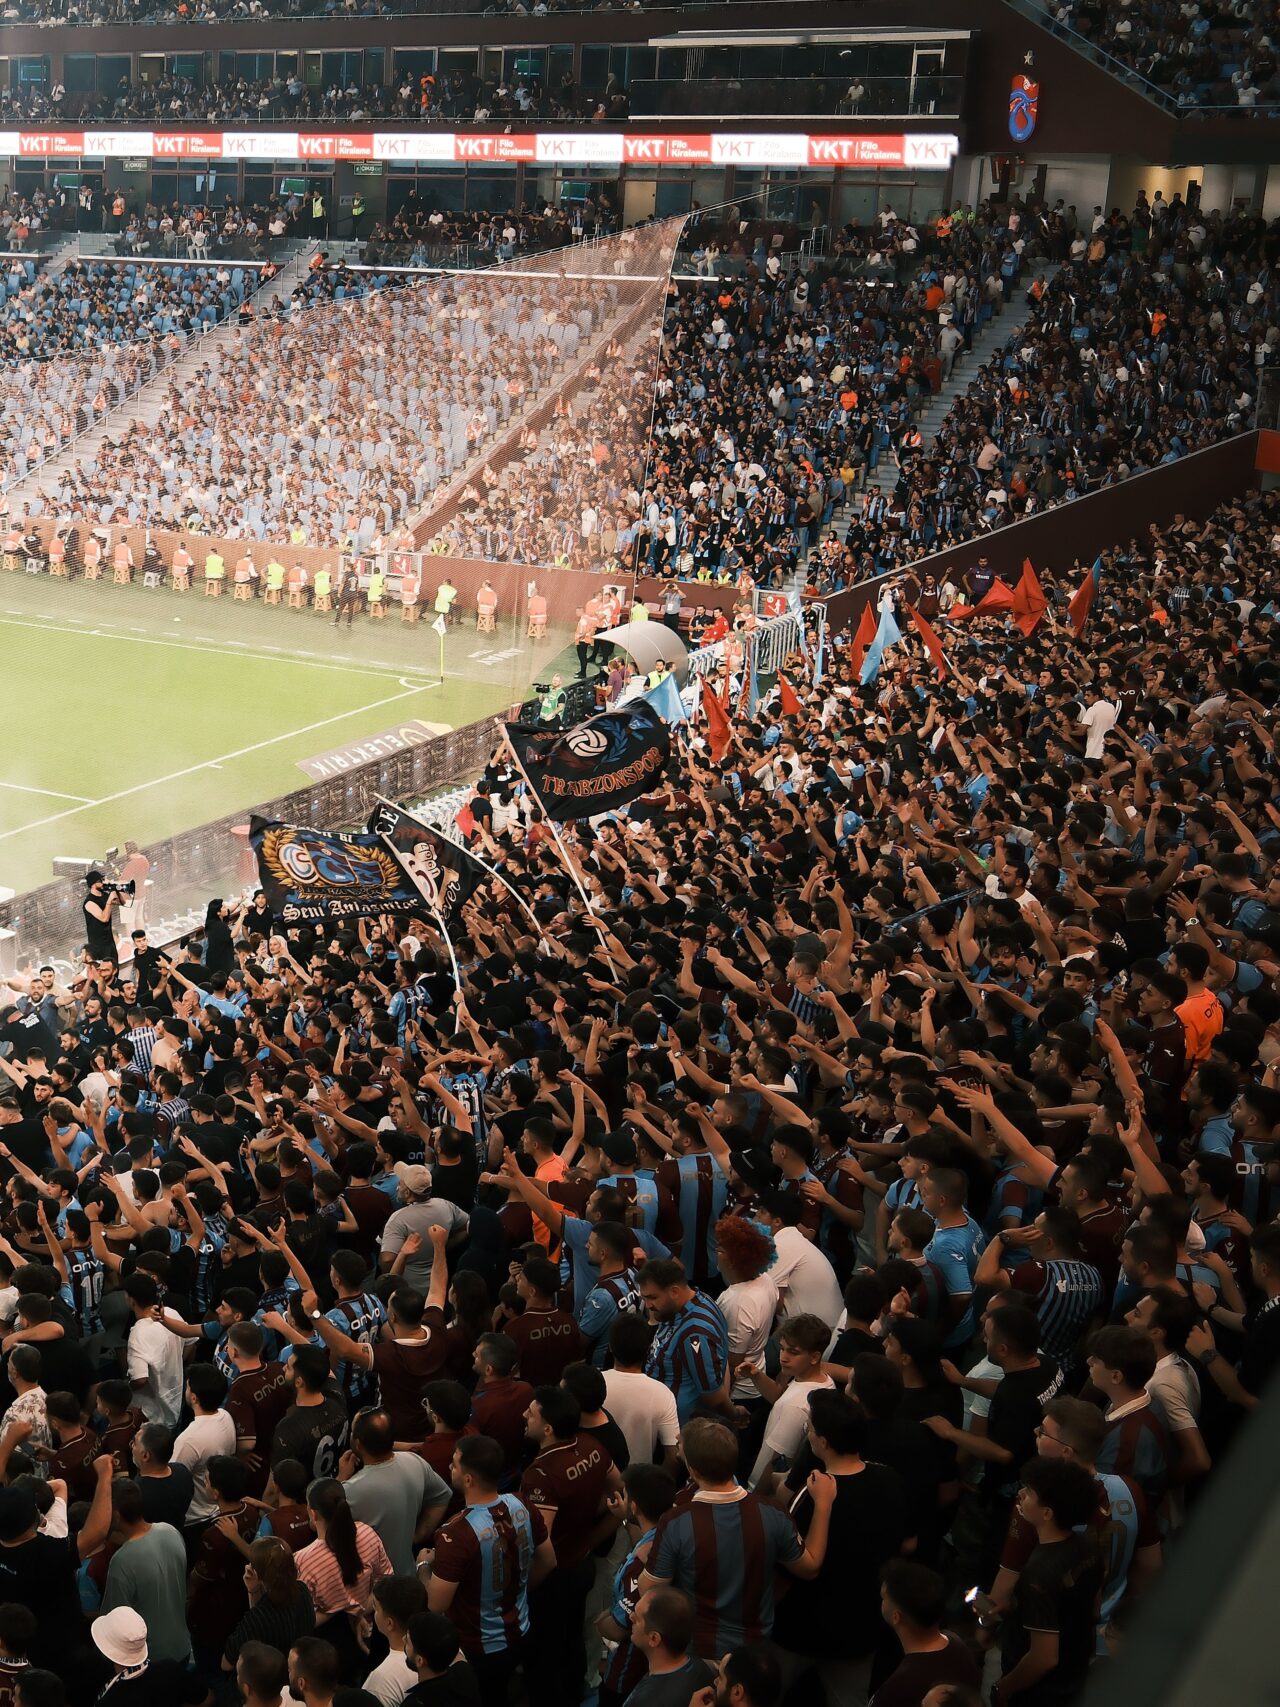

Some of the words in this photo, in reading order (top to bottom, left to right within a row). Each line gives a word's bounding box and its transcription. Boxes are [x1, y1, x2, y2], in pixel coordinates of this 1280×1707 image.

[21, 137, 49, 152] YKT
[89, 138, 116, 150] YKT
[155, 137, 186, 153] YKT
[191, 145, 220, 153] Kiralama
[227, 139, 256, 152] YKT
[300, 138, 332, 154] YKT
[339, 146, 371, 154] Kiralama
[378, 140, 409, 154] YKT
[457, 139, 492, 155] YKT
[541, 141, 576, 155] YKT
[626, 140, 664, 157] YKT
[718, 142, 755, 156] YKT
[810, 141, 851, 159] YKT
[861, 142, 878, 150] Filo
[911, 143, 950, 158] YKT
[500, 148, 533, 156] Kiralama
[672, 149, 708, 158] Kiralama
[861, 151, 900, 160] Kiralama
[542, 746, 665, 797] TRABZONSPOR
[282, 900, 324, 922] Seni
[457, 1089, 480, 1114] 61
[1236, 1162, 1265, 1175] on
[199, 1243, 214, 1254] vo
[80, 1271, 104, 1308] 10
[618, 1287, 642, 1310] onv
[350, 1307, 381, 1331] onvo
[529, 1323, 571, 1341] onvo
[254, 1374, 286, 1403] onvo
[565, 1449, 601, 1481] onvo
